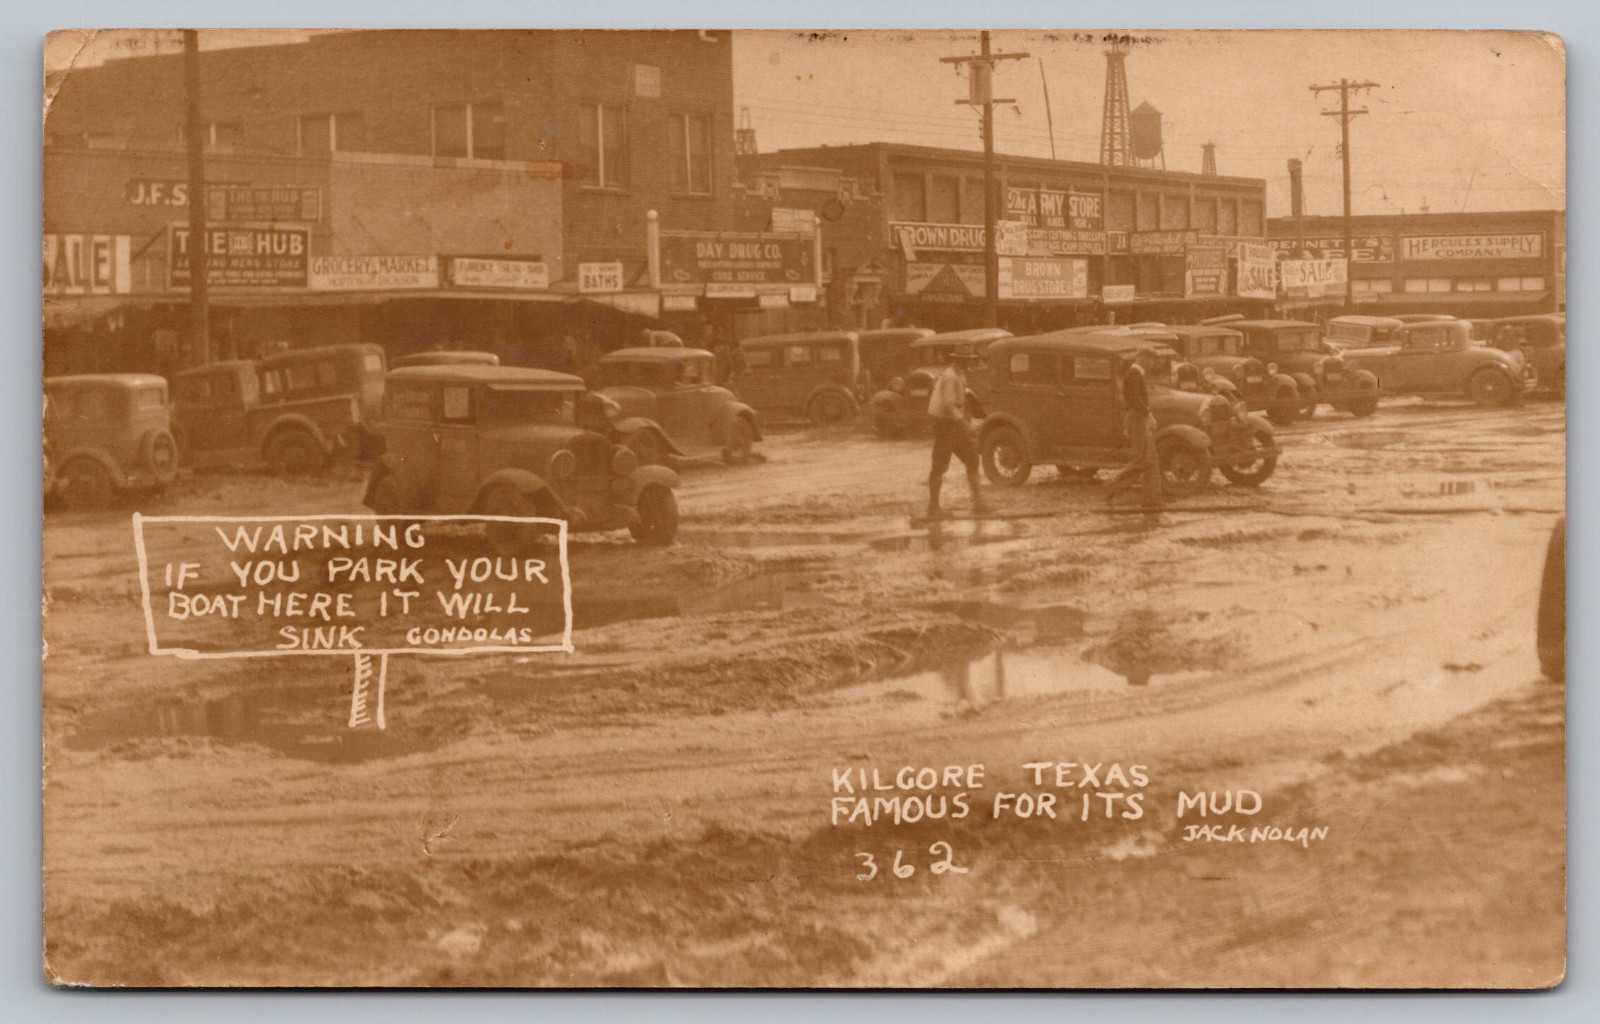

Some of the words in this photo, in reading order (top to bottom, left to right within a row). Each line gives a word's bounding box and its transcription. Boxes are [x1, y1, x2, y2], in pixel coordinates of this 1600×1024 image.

[1027, 192, 1064, 216] ARMY
[1069, 196, 1100, 218] STORE
[175, 231, 227, 254] TE
[256, 233, 304, 256] HUB
[696, 243, 724, 258] DAY
[728, 243, 763, 259] DRUG
[1409, 237, 1481, 257] HERCULES
[1486, 237, 1536, 253] SUPPLY
[1434, 248, 1503, 257] COMPANY
[312, 256, 369, 276] GROCERY
[1025, 262, 1061, 276] BROWN
[583, 274, 618, 289] BATHS
[1012, 279, 1037, 294] DRUG
[1038, 280, 1067, 294] STORE
